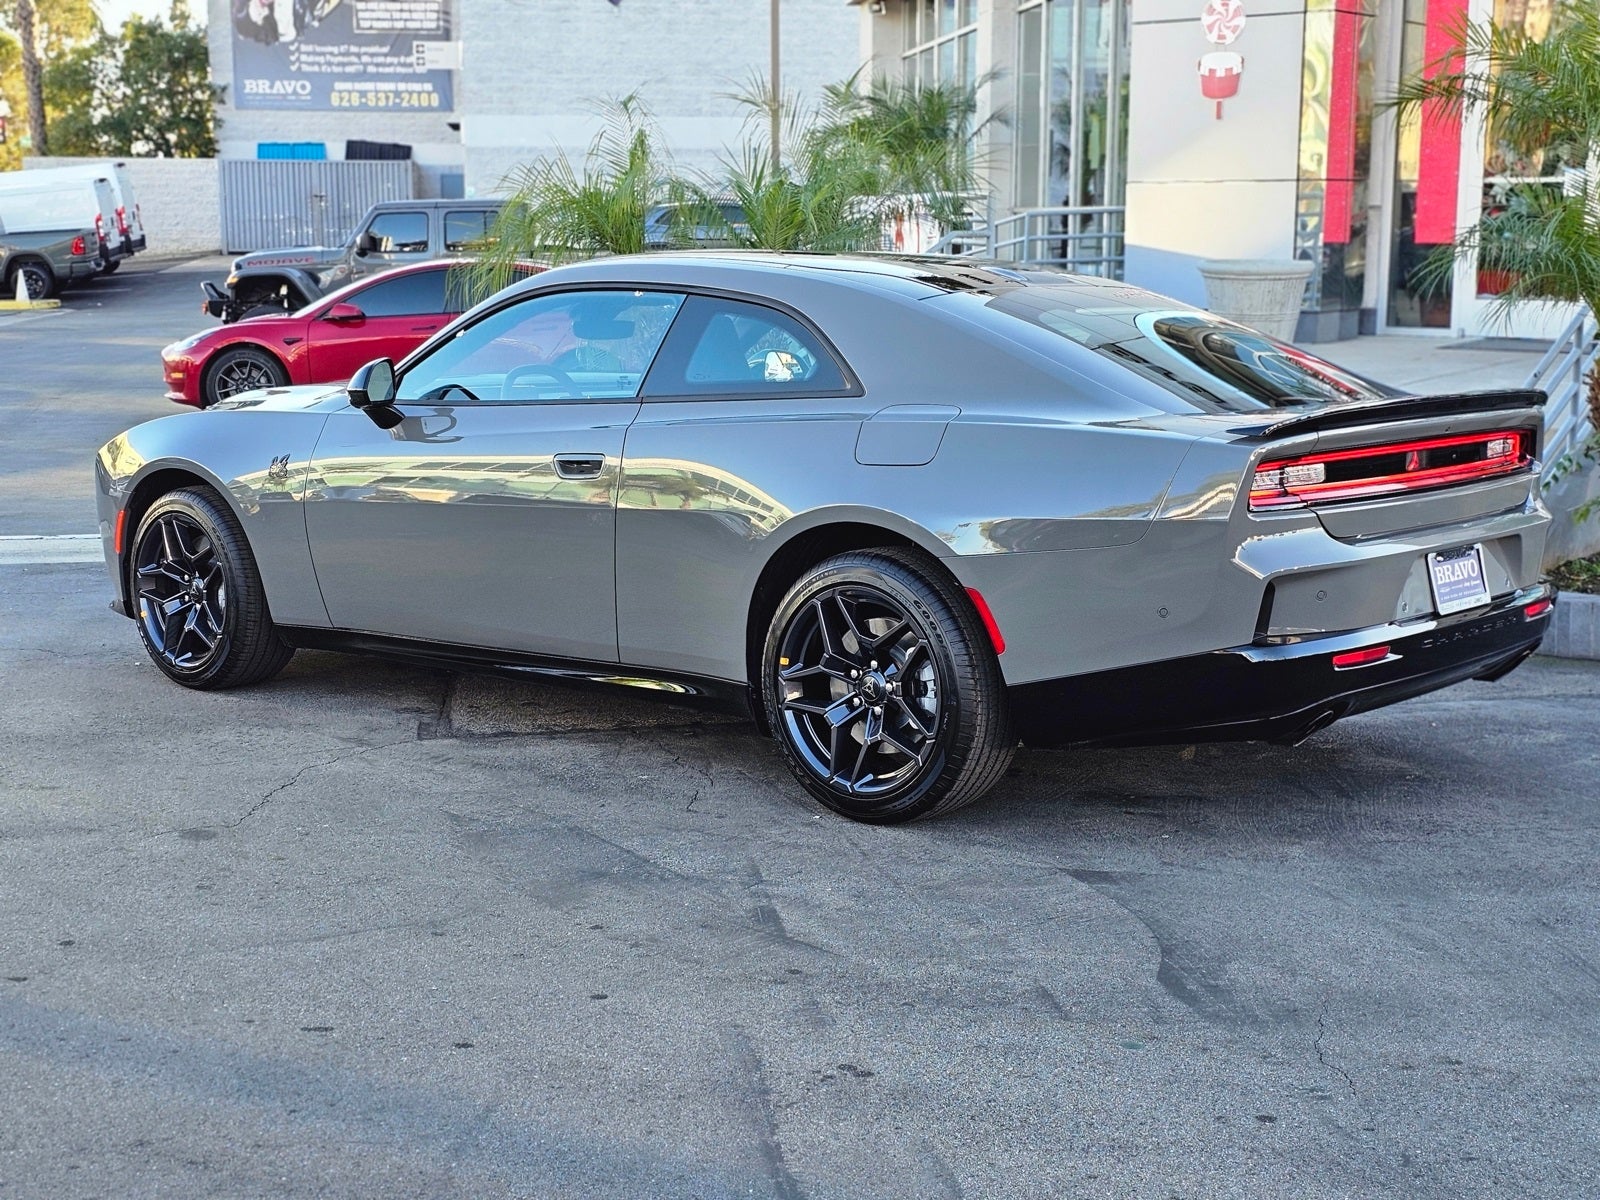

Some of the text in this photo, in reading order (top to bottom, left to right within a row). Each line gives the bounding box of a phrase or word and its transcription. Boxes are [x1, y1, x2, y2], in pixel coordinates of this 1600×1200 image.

[244, 79, 312, 95] BRAVO
[330, 91, 439, 107] 626-537-2400
[247, 256, 315, 267] MOJAVE
[1434, 559, 1478, 585] BRAVO
